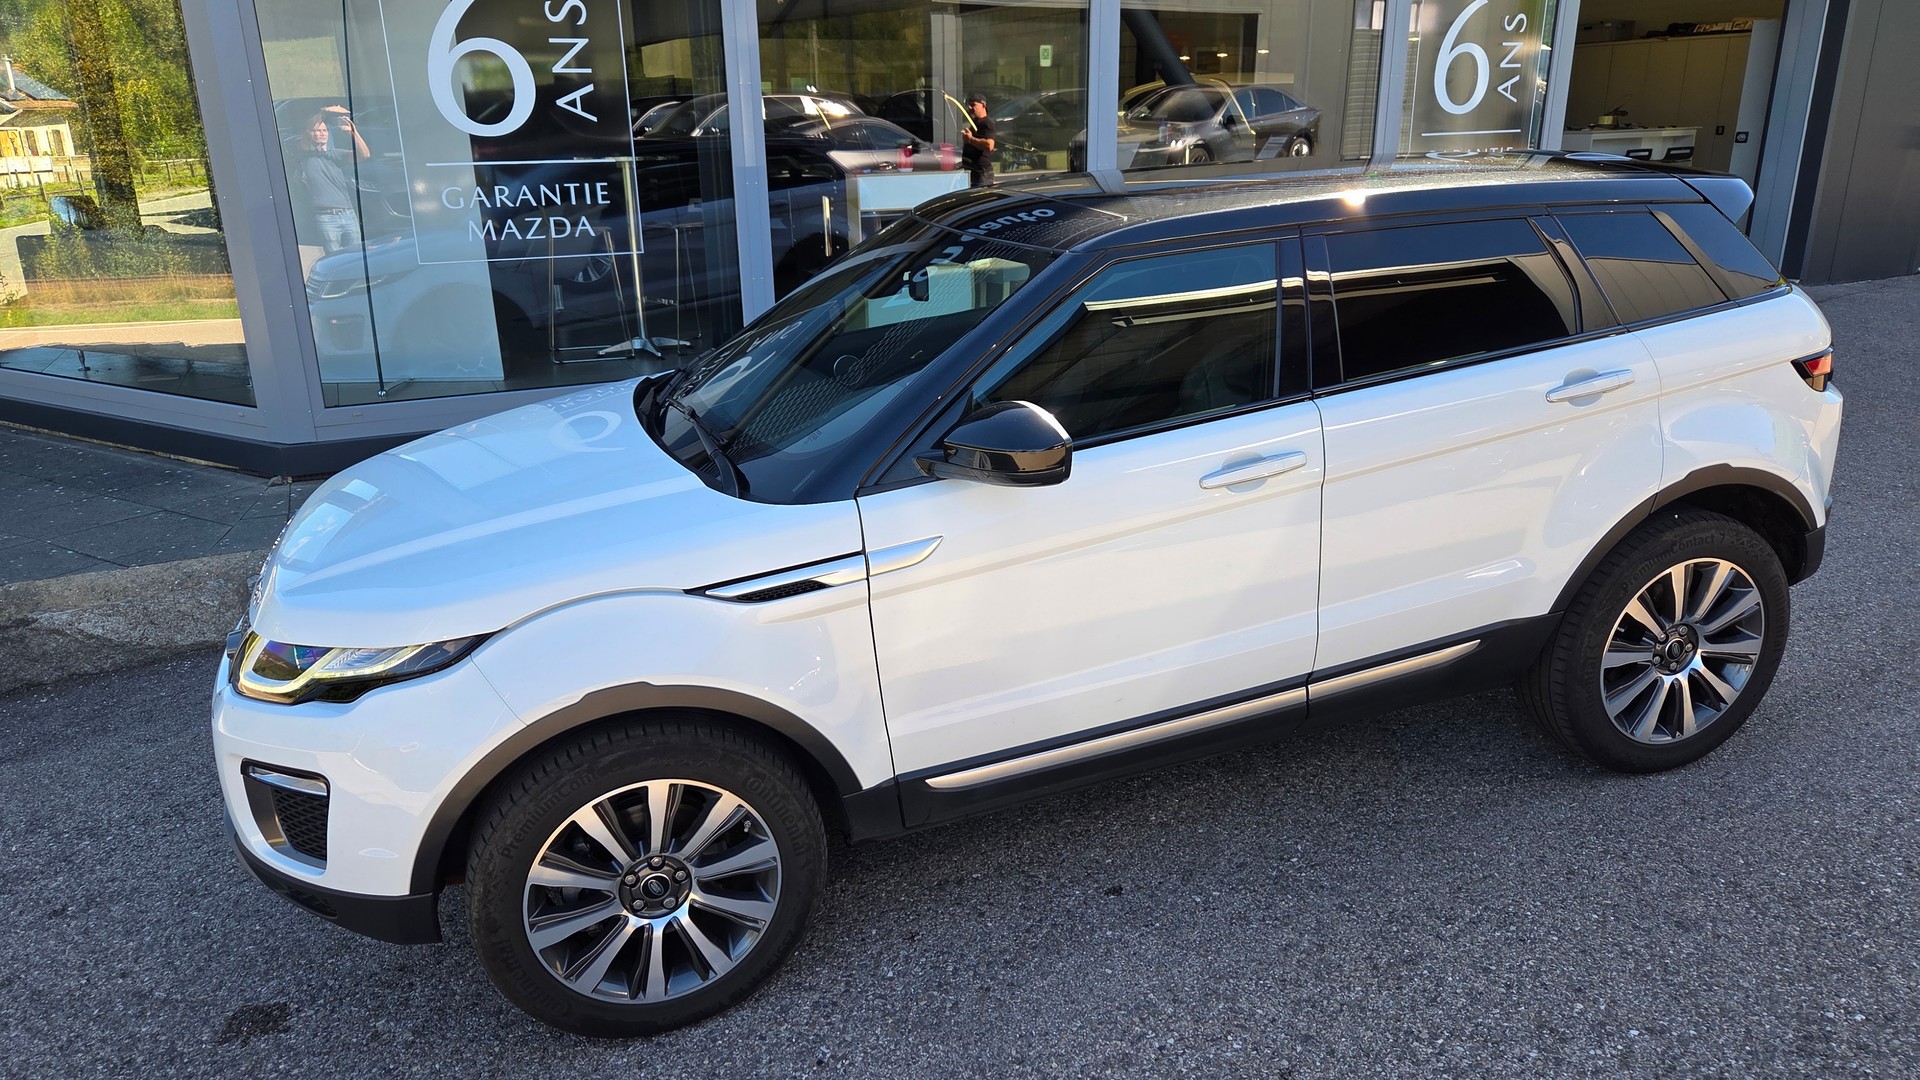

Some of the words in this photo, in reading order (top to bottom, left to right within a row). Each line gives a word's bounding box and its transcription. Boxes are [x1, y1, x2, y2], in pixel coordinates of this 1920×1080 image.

[427, 0, 536, 137] 6
[544, 0, 598, 122] ANS
[1434, 0, 1490, 115] 6
[1497, 13, 1527, 103] ANS
[441, 182, 611, 210] GARANTIE
[468, 215, 596, 242] MAZDA
